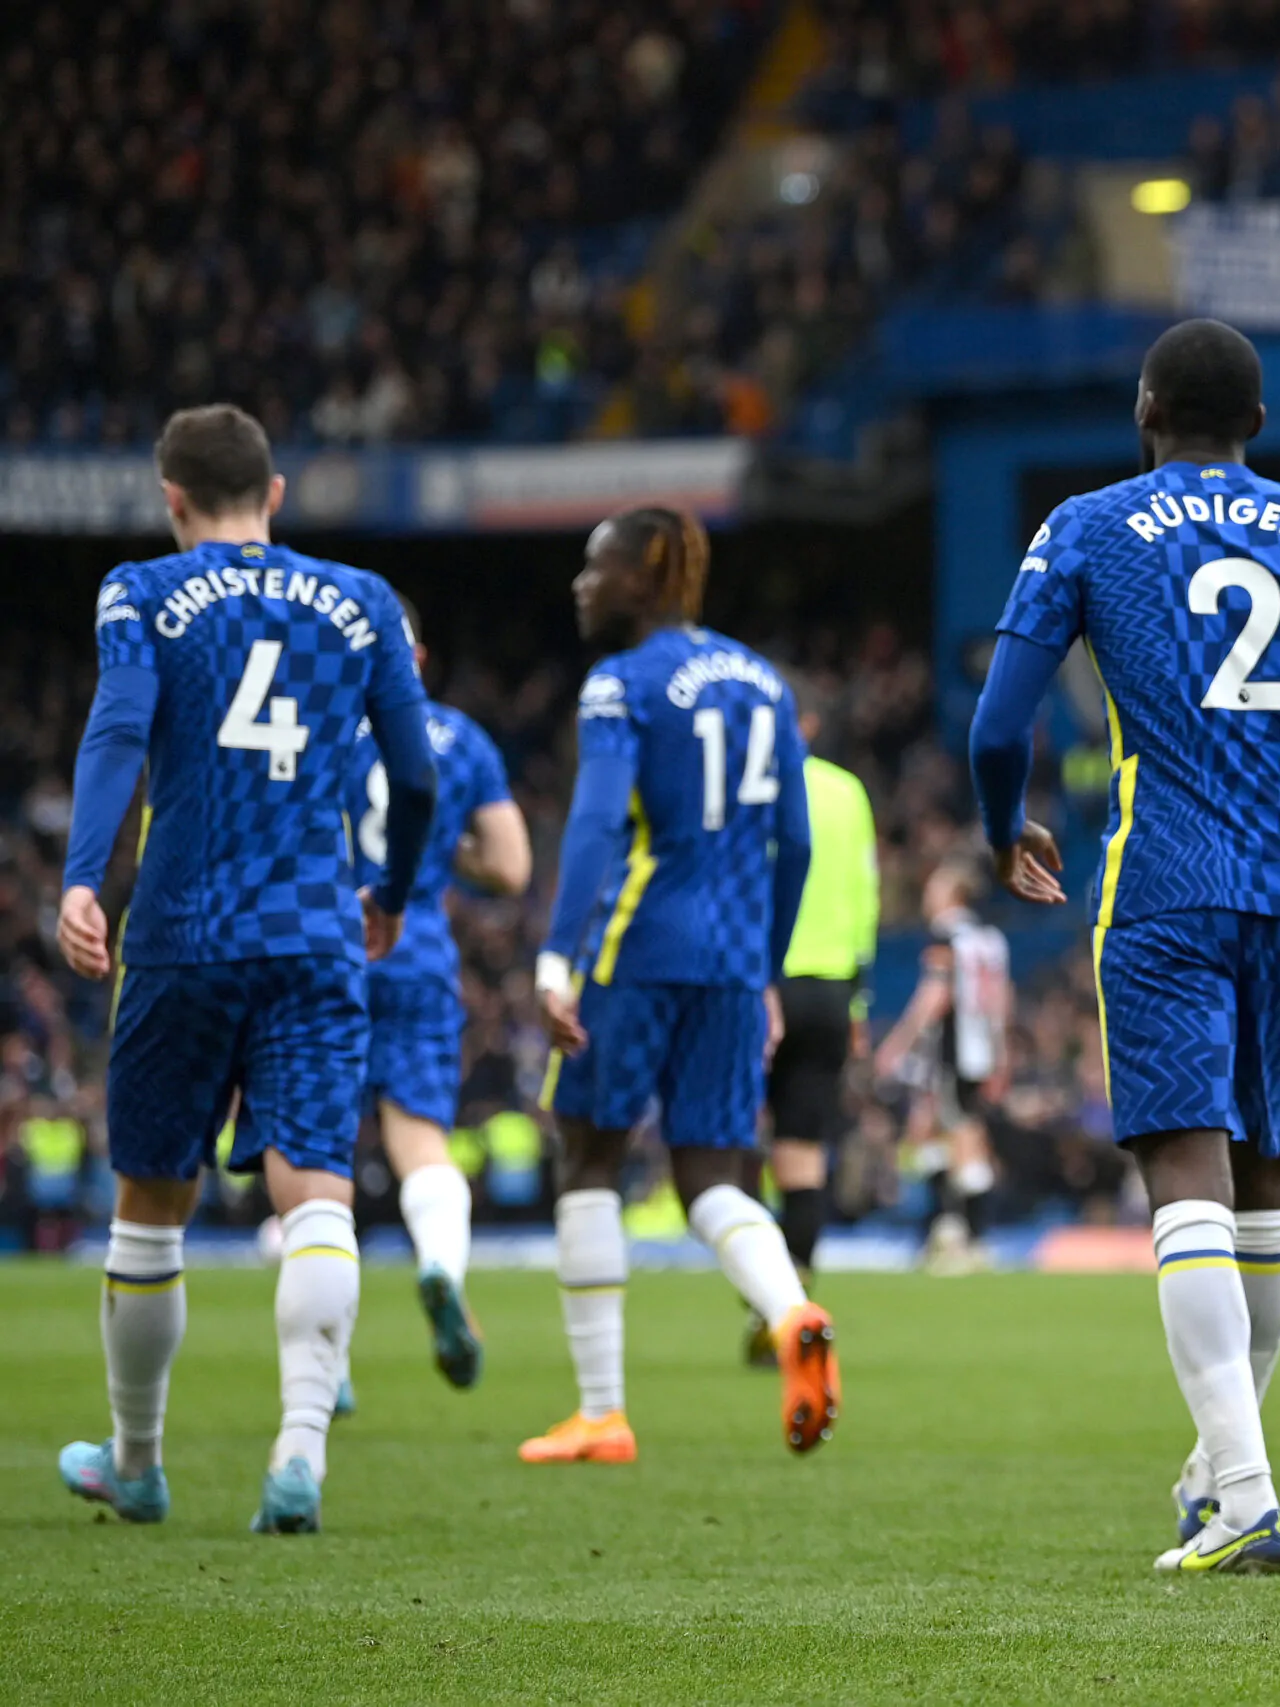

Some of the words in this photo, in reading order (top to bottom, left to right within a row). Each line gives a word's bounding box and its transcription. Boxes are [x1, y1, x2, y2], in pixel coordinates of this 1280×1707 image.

[155, 567, 377, 652] CHRISTENSEN
[217, 639, 309, 781] 4
[693, 705, 780, 831] 14
